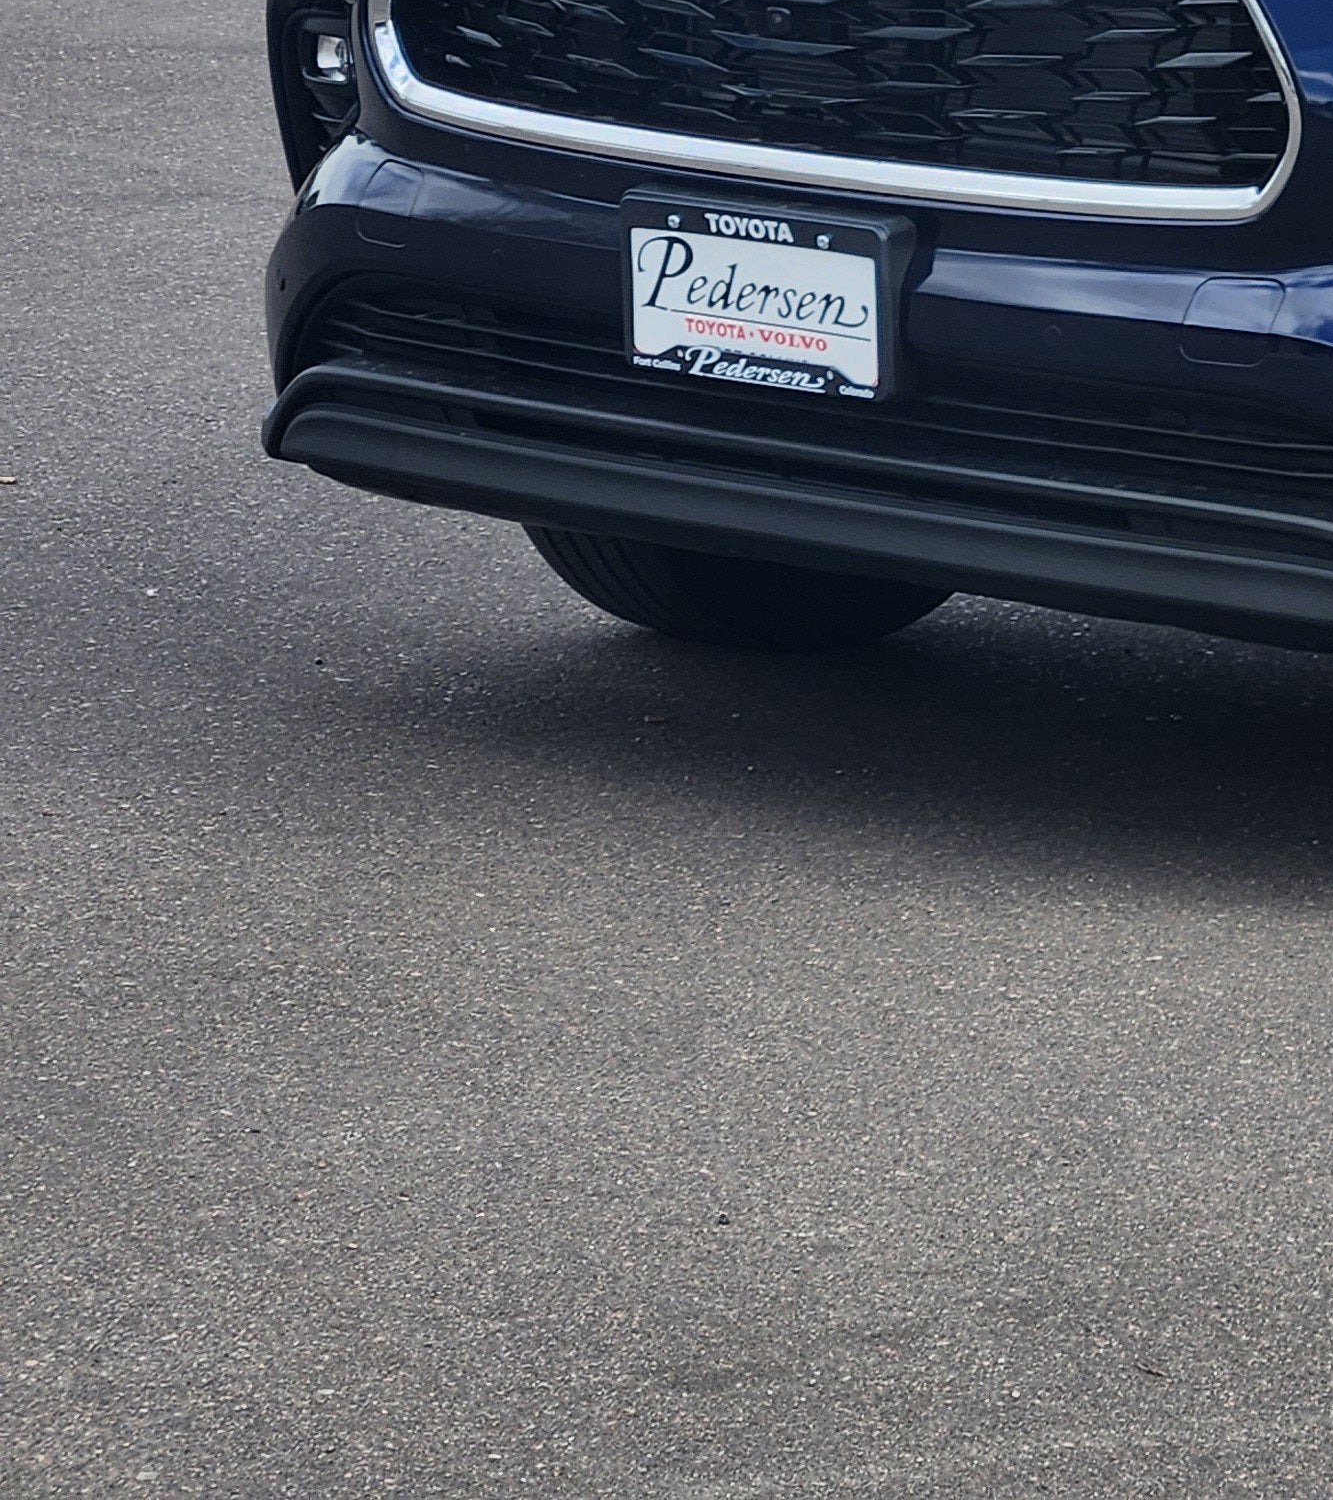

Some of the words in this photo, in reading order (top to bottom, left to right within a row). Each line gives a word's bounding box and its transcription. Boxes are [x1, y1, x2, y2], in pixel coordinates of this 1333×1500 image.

[704, 212, 794, 243] TOYOTA
[638, 236, 869, 328] Pedersen
[685, 317, 747, 341] TOYOTA
[758, 328, 828, 352] VOLVO
[685, 346, 825, 388] Pedersen
